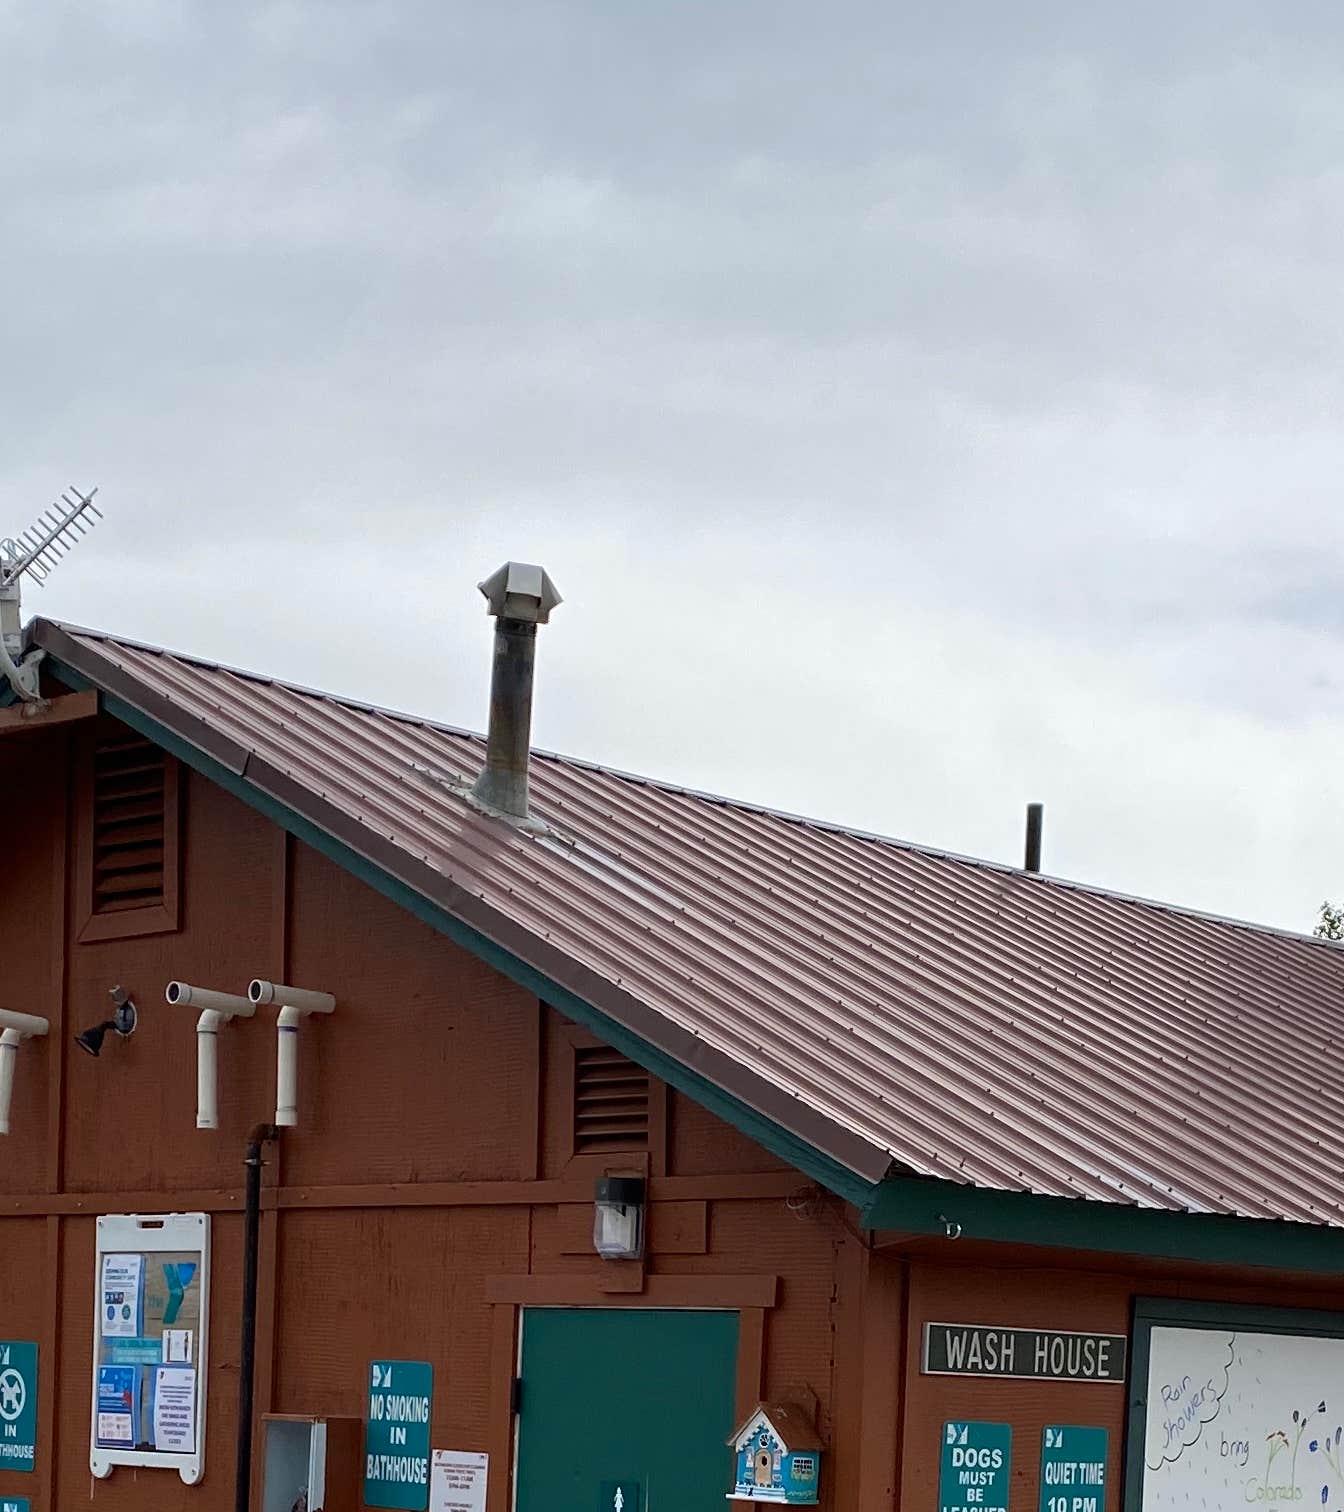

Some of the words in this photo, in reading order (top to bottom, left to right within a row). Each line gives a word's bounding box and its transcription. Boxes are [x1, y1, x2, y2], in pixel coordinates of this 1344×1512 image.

[945, 1330, 1015, 1372] WASH
[1034, 1336, 1111, 1377] HOUSE
[370, 1394, 384, 1421] NO
[386, 1396, 429, 1424] SMOKING
[4, 1423, 17, 1437] IN
[390, 1426, 406, 1445] IN
[366, 1454, 427, 1484] BATHHOUSE
[951, 1447, 1003, 1469] DOGS
[958, 1471, 996, 1486] MUST
[1045, 1461, 1077, 1485] QUIET
[1079, 1462, 1104, 1485] TIME
[966, 1488, 984, 1502] BE
[1244, 1477, 1304, 1503] Colorado
